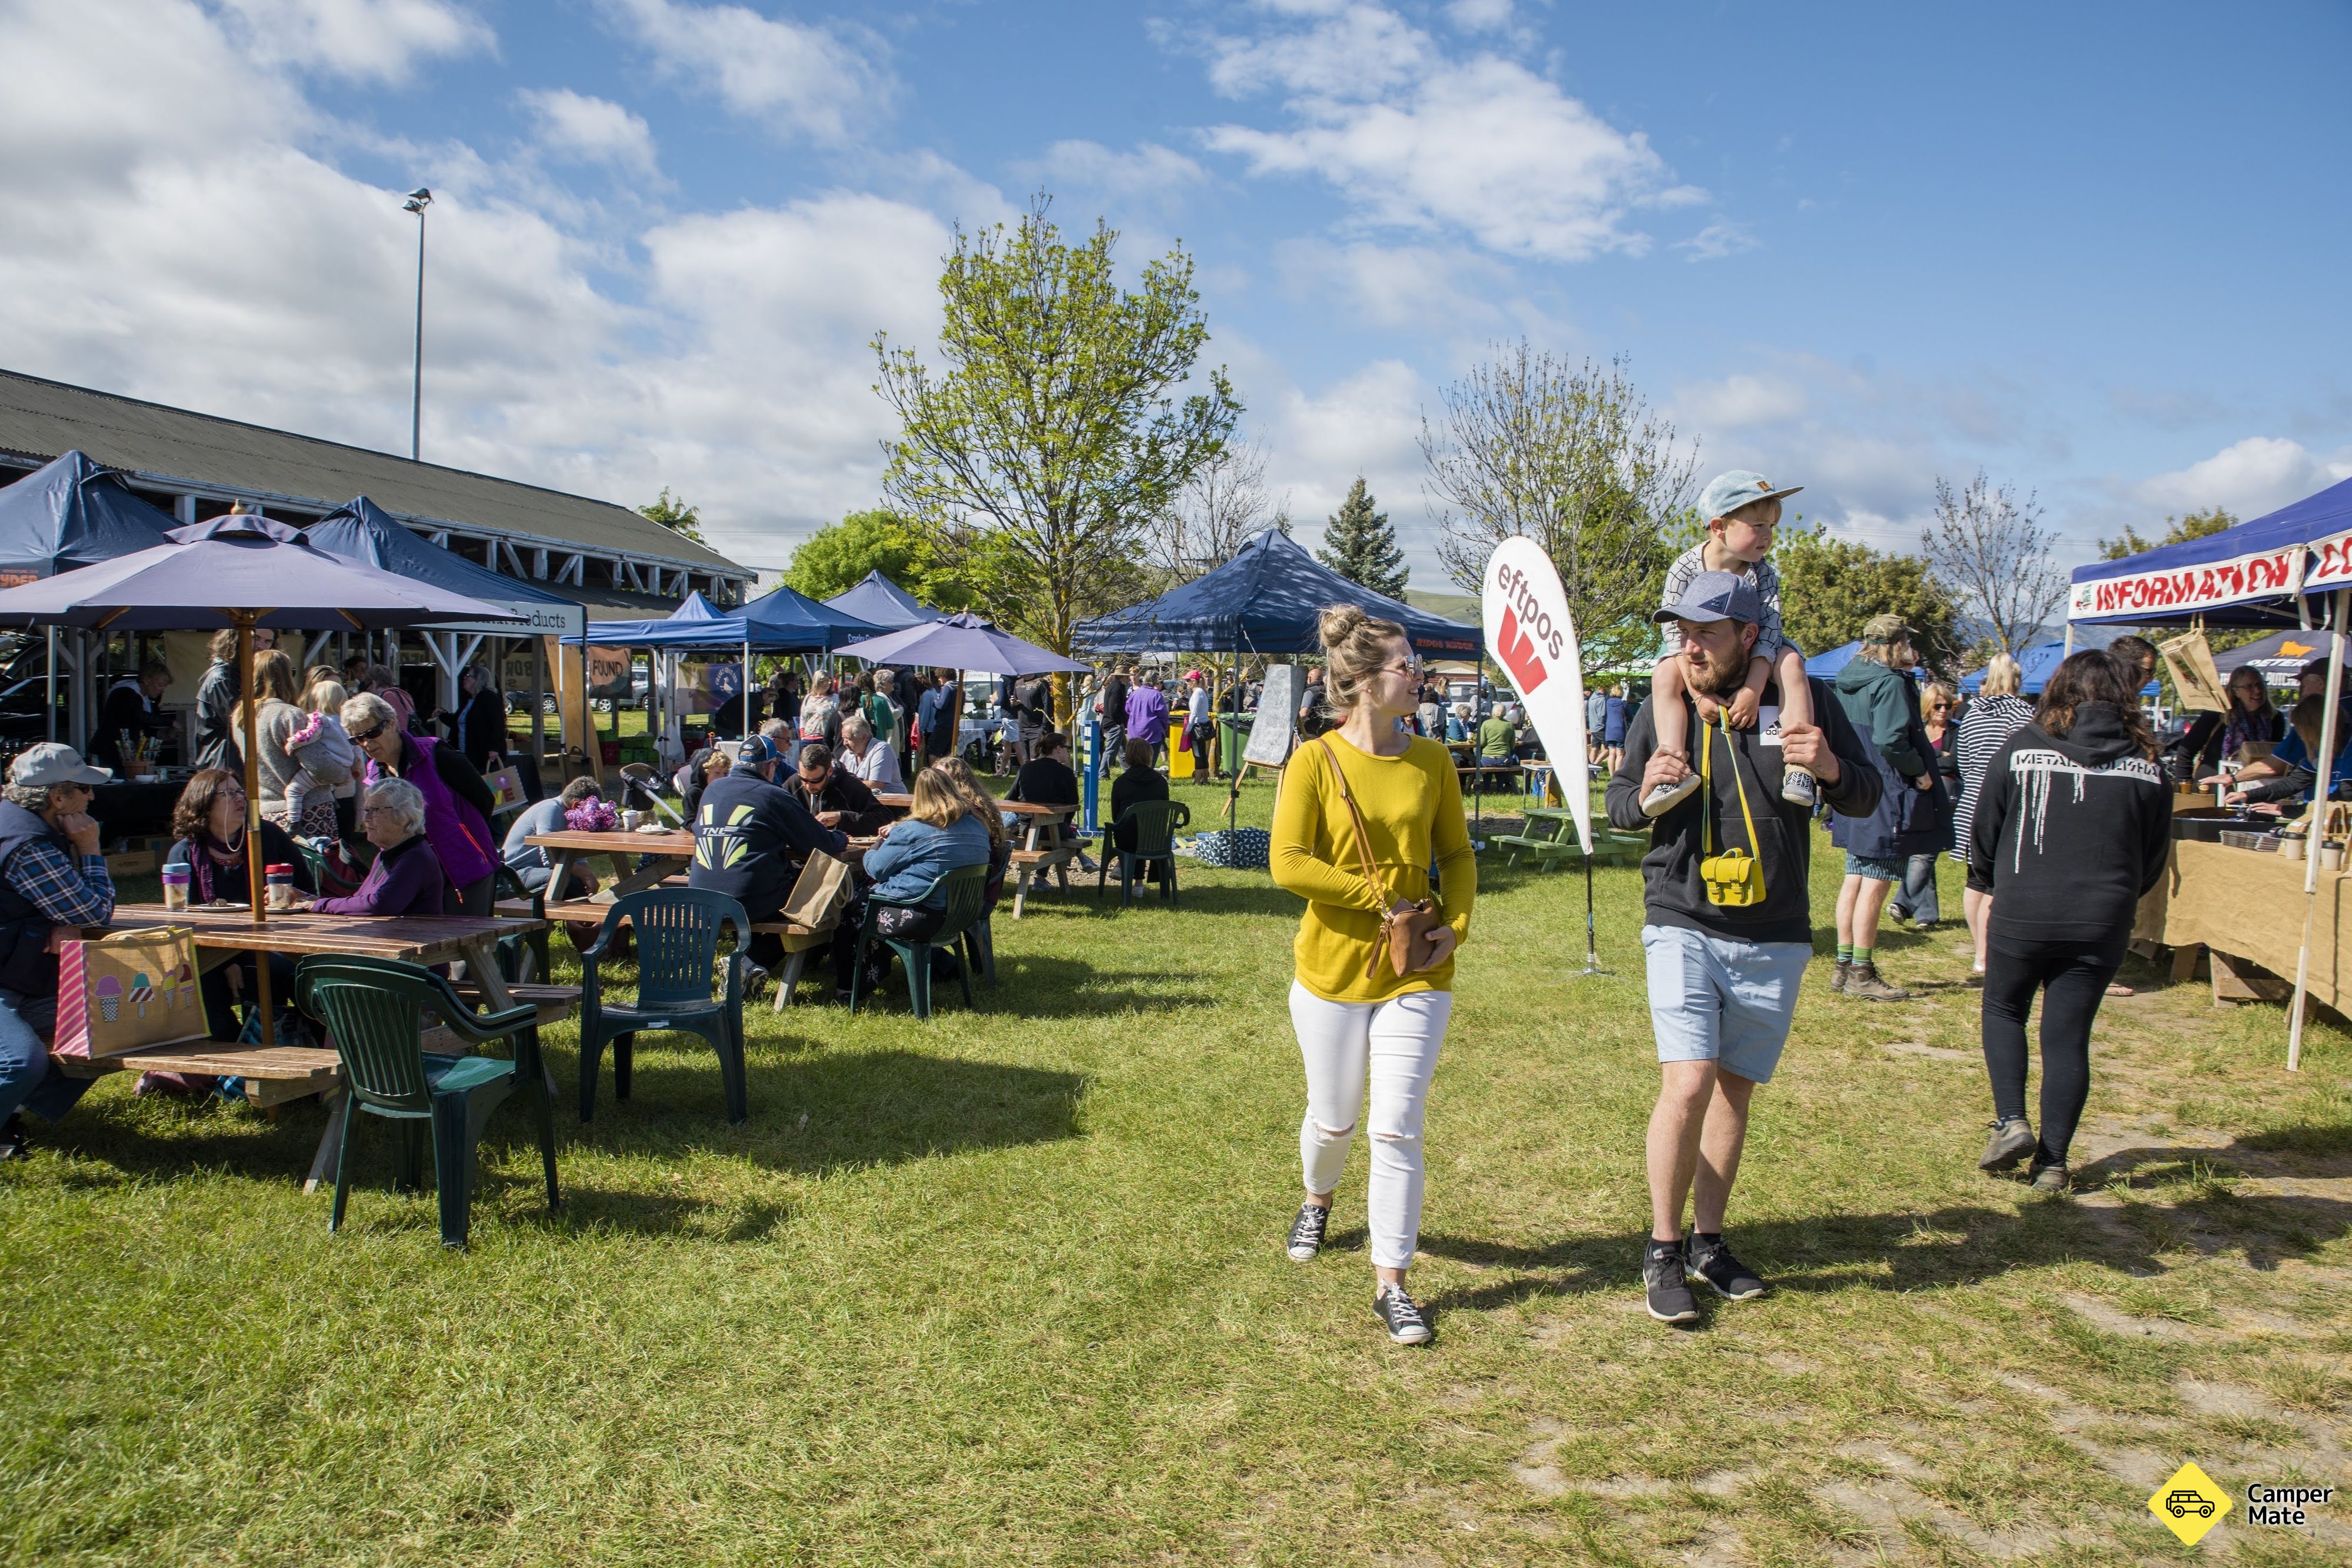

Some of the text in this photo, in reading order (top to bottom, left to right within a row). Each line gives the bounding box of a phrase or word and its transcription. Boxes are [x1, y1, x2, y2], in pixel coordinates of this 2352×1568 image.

[2096, 551, 2293, 611] INFORMATION
[1498, 564, 1563, 660] eftpos
[592, 659, 623, 677] FOUND
[2017, 754, 2158, 777] METAL LISHA
